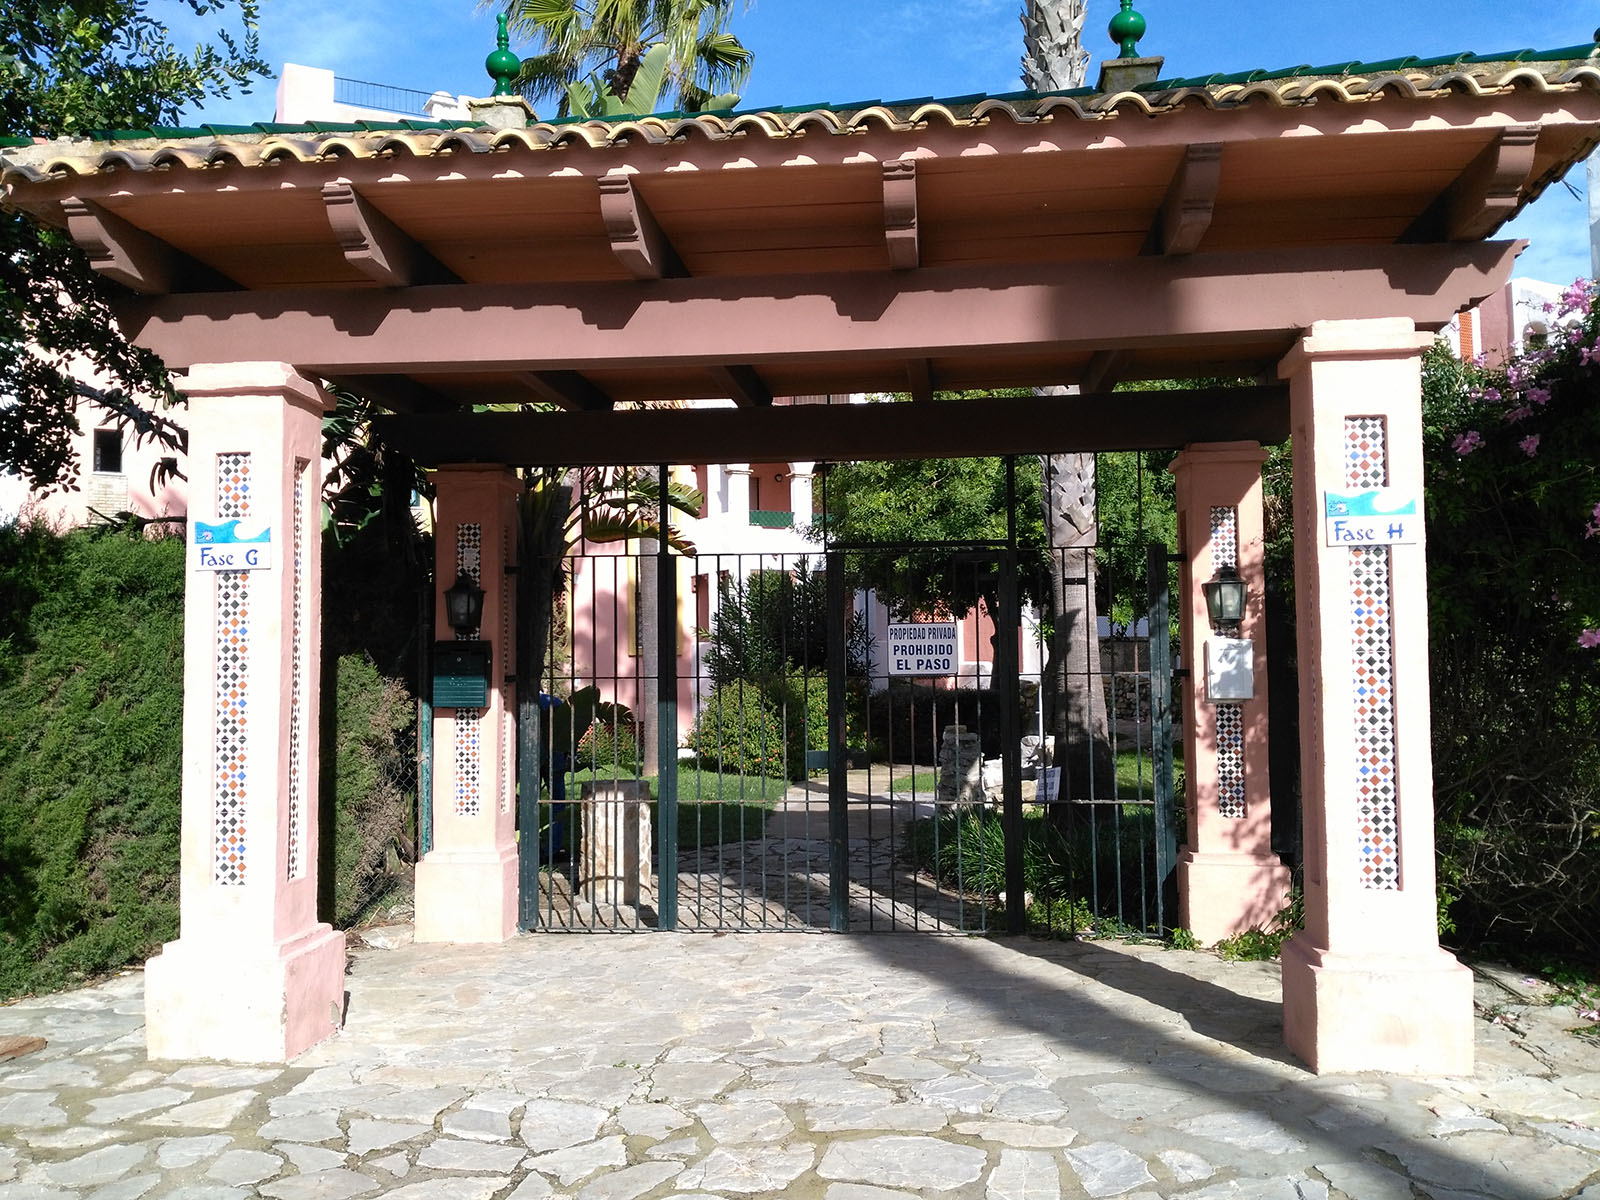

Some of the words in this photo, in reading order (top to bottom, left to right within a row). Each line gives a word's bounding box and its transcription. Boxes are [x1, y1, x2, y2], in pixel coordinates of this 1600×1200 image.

[1334, 520, 1375, 542] Fase
[1387, 522, 1404, 540] H
[200, 547, 234, 566] Fase
[245, 549, 258, 566] G
[890, 627, 926, 640] PROPIEDAD
[928, 627, 957, 640] PRIVADA
[893, 644, 953, 656] PROHIBIDO
[896, 659, 911, 670] EL
[916, 658, 950, 670] PASO
